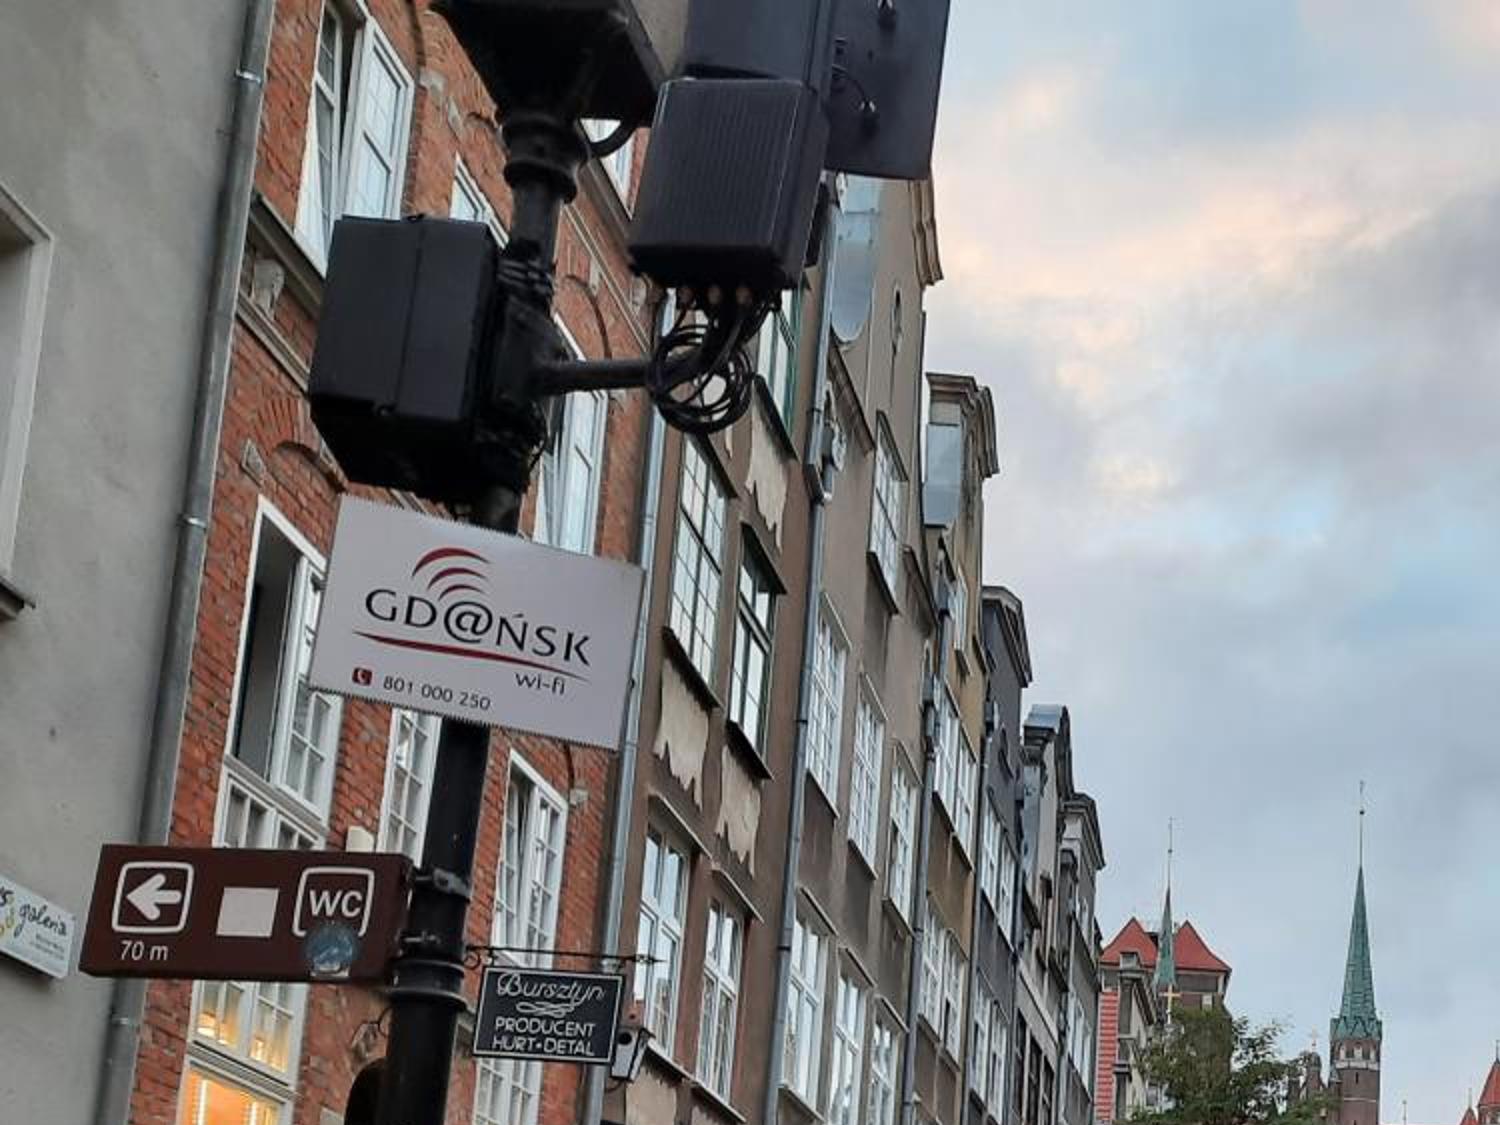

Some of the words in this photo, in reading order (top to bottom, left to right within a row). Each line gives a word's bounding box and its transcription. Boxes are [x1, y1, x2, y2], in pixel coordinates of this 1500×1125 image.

[383, 674, 414, 694] 801
[421, 683, 453, 703] 000
[459, 691, 491, 711] 250
[515, 671, 565, 696] wi-fi
[309, 888, 363, 918] WC
[120, 939, 144, 961] 70
[149, 943, 169, 961] m
[496, 972, 605, 1007] Bursztyn
[495, 1016, 596, 1038] PRODUCENT
